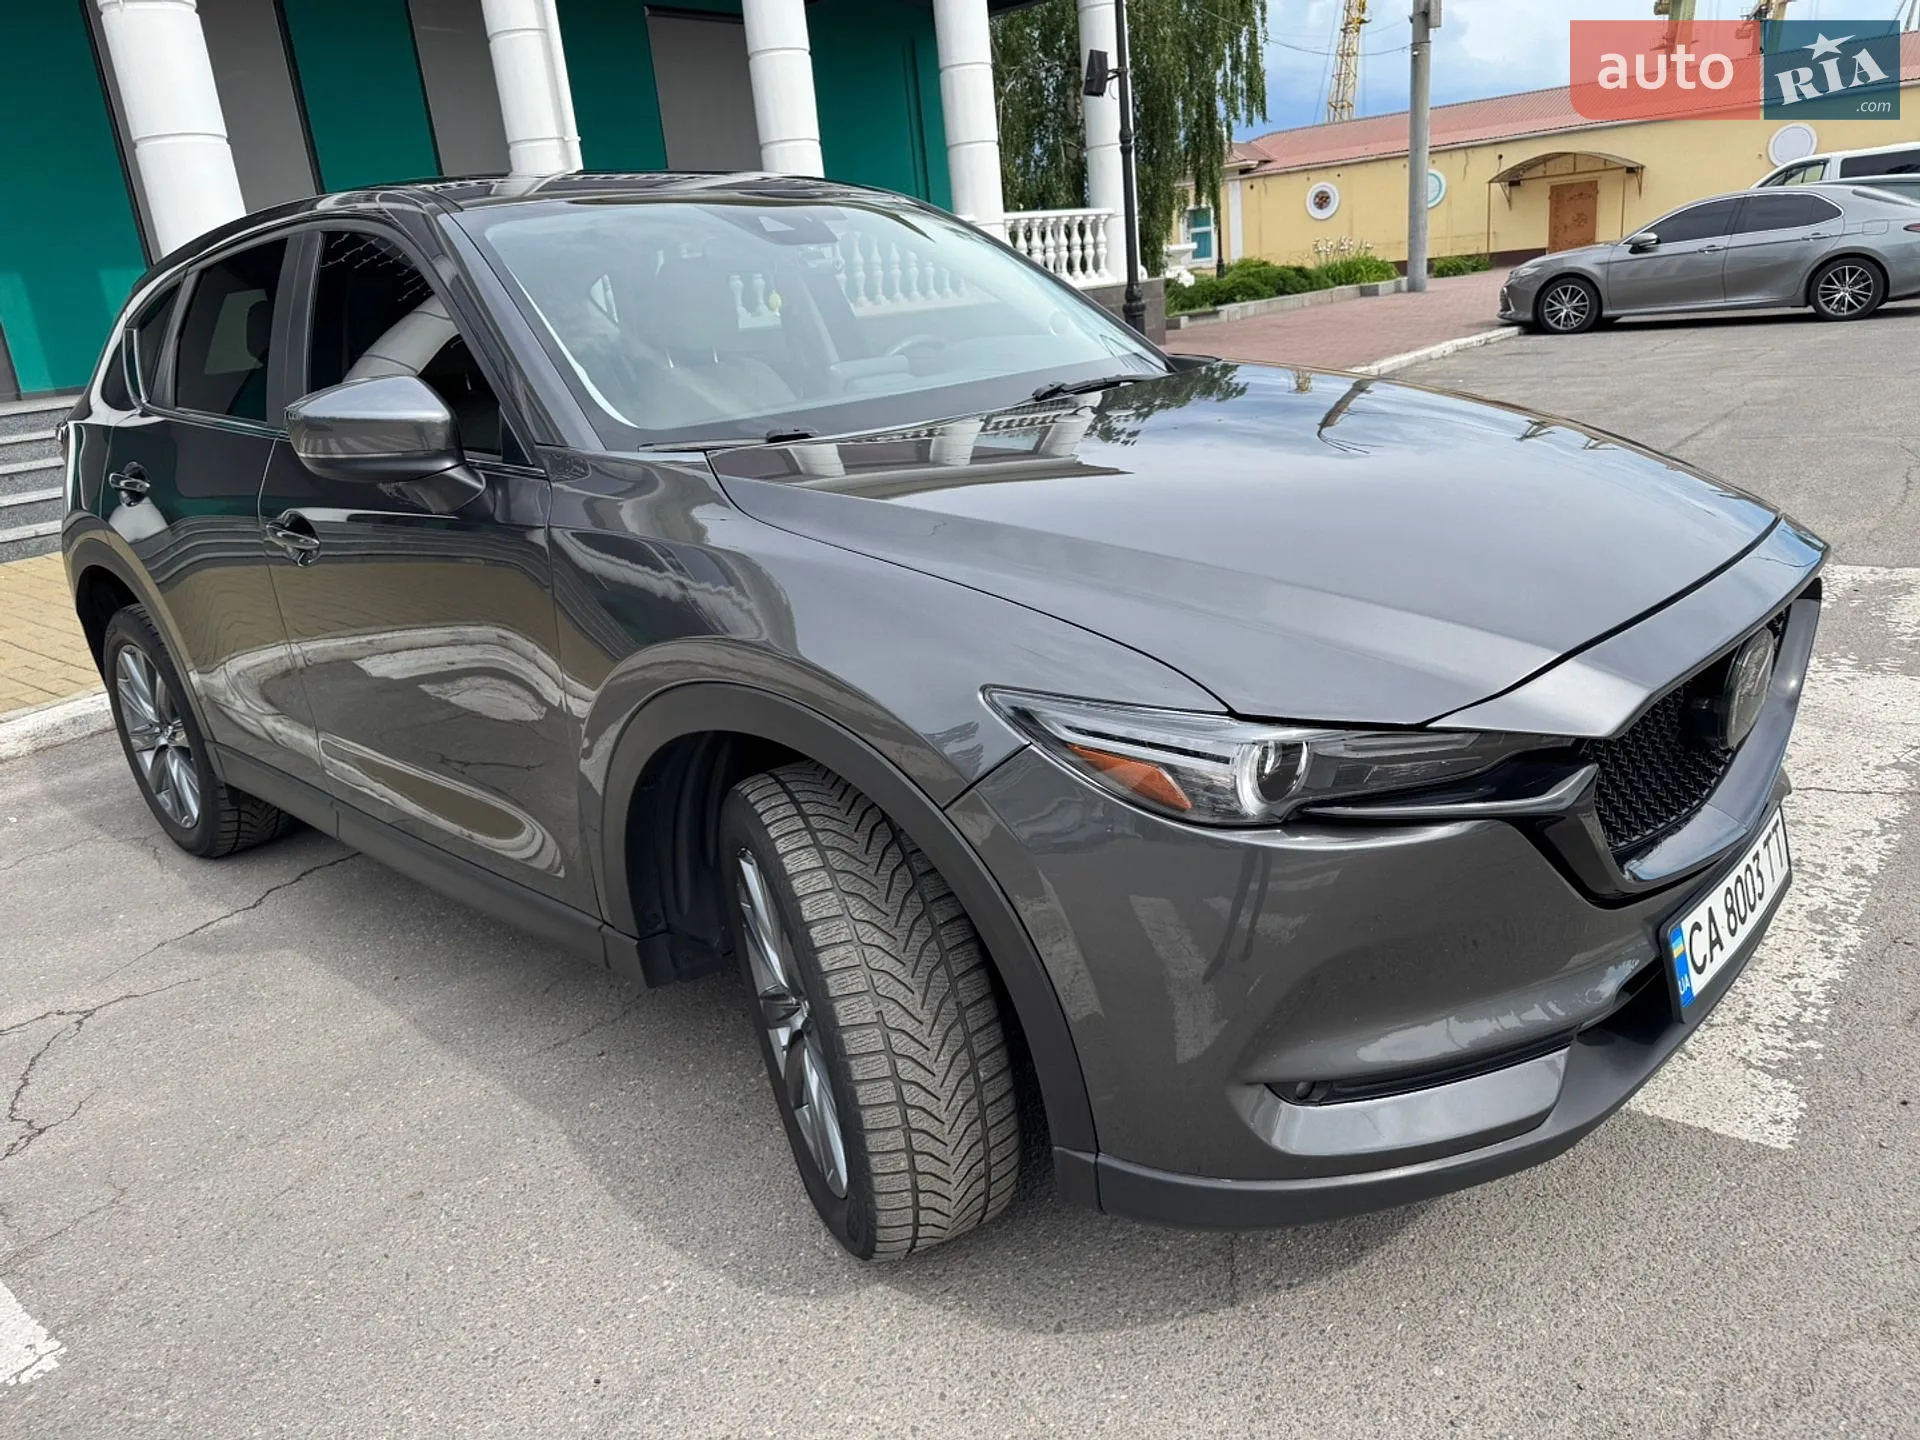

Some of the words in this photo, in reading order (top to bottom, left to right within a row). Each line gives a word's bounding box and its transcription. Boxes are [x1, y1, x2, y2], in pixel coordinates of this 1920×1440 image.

[1689, 905, 1724, 976] CA
[1724, 850, 1765, 938] 8003
[1763, 818, 1784, 883] TT
[1678, 973, 1691, 995] UA
